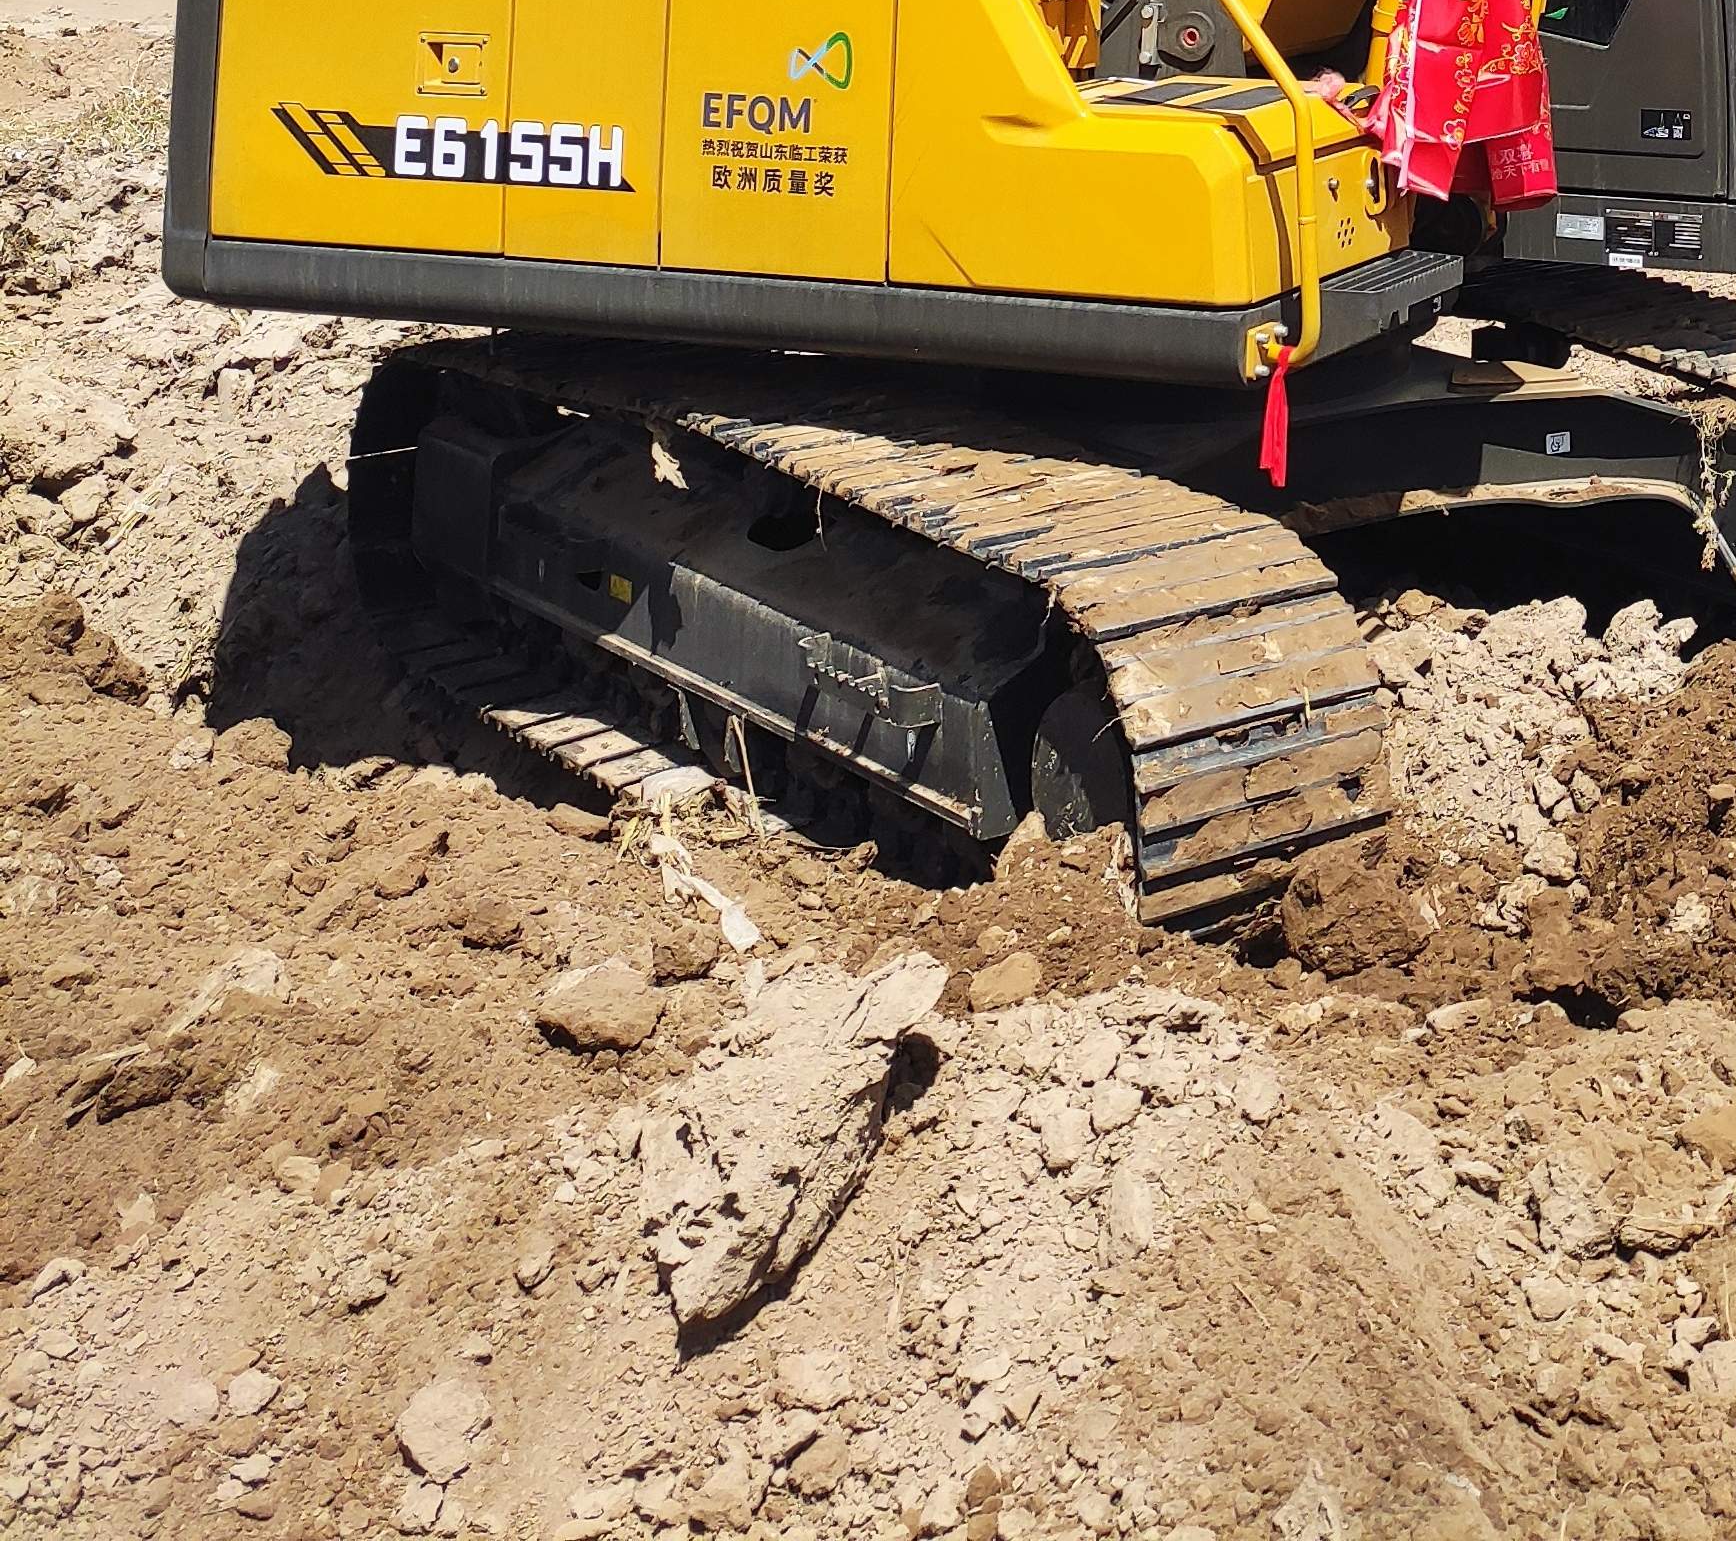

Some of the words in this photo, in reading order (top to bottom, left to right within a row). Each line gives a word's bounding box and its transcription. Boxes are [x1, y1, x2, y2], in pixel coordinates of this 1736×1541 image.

[702, 92, 812, 134] EFQM
[393, 114, 624, 187] E6155H
[701, 138, 849, 164] 热烈祝贺山东临工荣获
[712, 165, 835, 196] 欧洲质量奖
